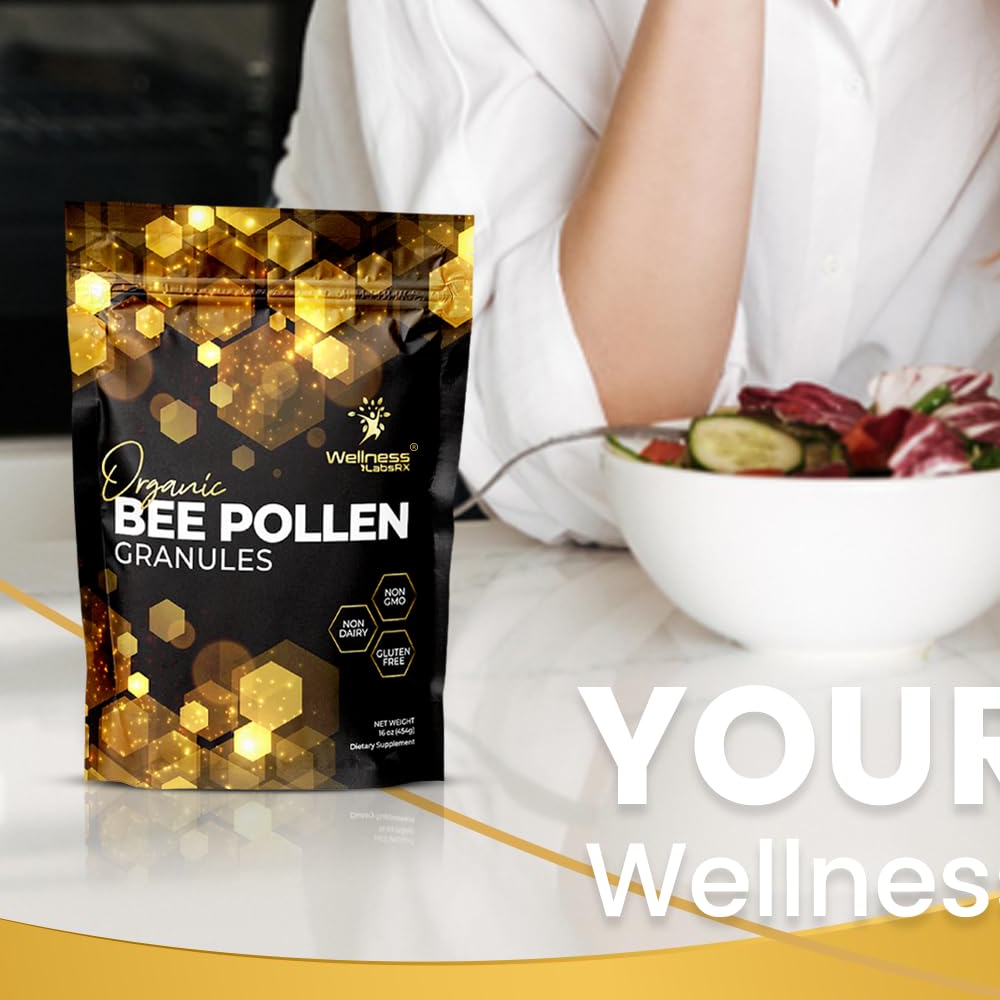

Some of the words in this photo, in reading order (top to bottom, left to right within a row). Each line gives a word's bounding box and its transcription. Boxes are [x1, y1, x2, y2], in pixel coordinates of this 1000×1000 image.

[325, 450, 411, 464] Wellness
[101, 440, 227, 511] Organic
[114, 496, 206, 541] BEE
[220, 502, 410, 543] POLLEN
[114, 541, 273, 572] GRANULES
[384, 587, 406, 597] NON
[383, 596, 407, 606] GMO
[342, 619, 365, 629] NON
[338, 628, 369, 638] DAIRY
[375, 647, 411, 659] GLUTEN
[382, 657, 405, 667] FREE
[373, 720, 388, 728] NET
[349, 742, 376, 751] Dietary
